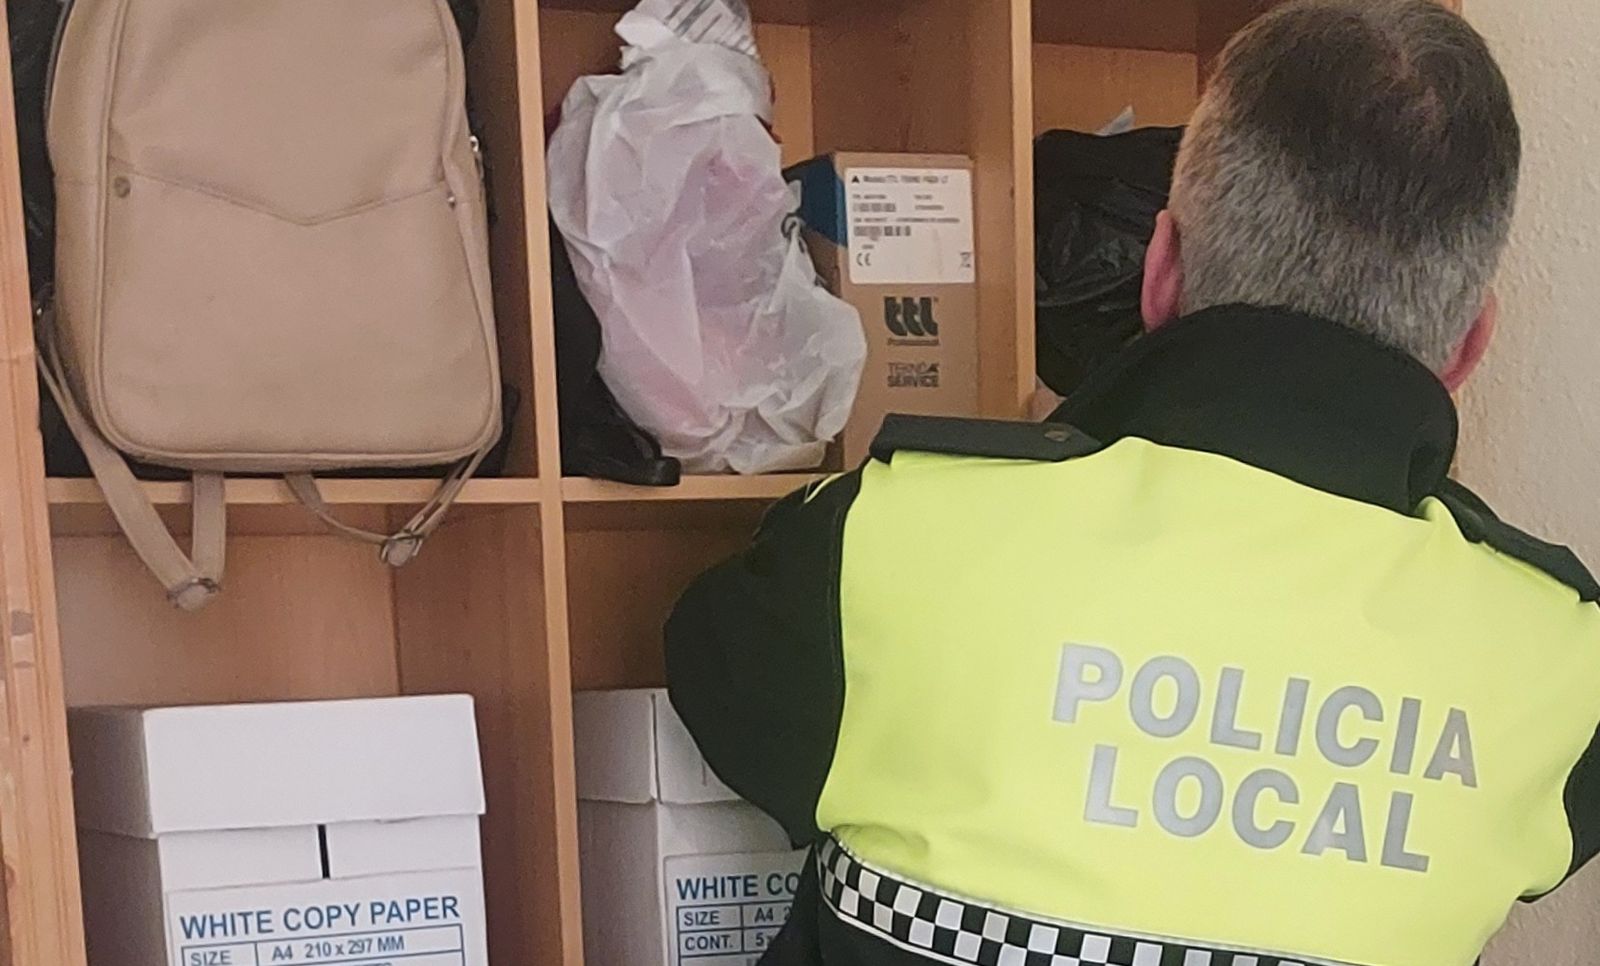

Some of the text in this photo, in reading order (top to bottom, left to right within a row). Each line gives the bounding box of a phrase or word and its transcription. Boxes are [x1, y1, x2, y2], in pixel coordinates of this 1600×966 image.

[887, 375, 939, 388] SERVICE
[1052, 643, 1477, 788] POLICIA
[1083, 744, 1429, 872] LOCAL
[677, 874, 758, 900] WHITE
[180, 896, 460, 939] WHITE COPY PAPER
[684, 910, 720, 927] SIZE
[754, 907, 774, 923] A4
[191, 950, 231, 966] SIZE
[271, 945, 293, 961] A4
[304, 941, 332, 959] 210
[347, 938, 373, 955] 297
[377, 935, 404, 953] MM
[685, 935, 733, 951] CONT.
